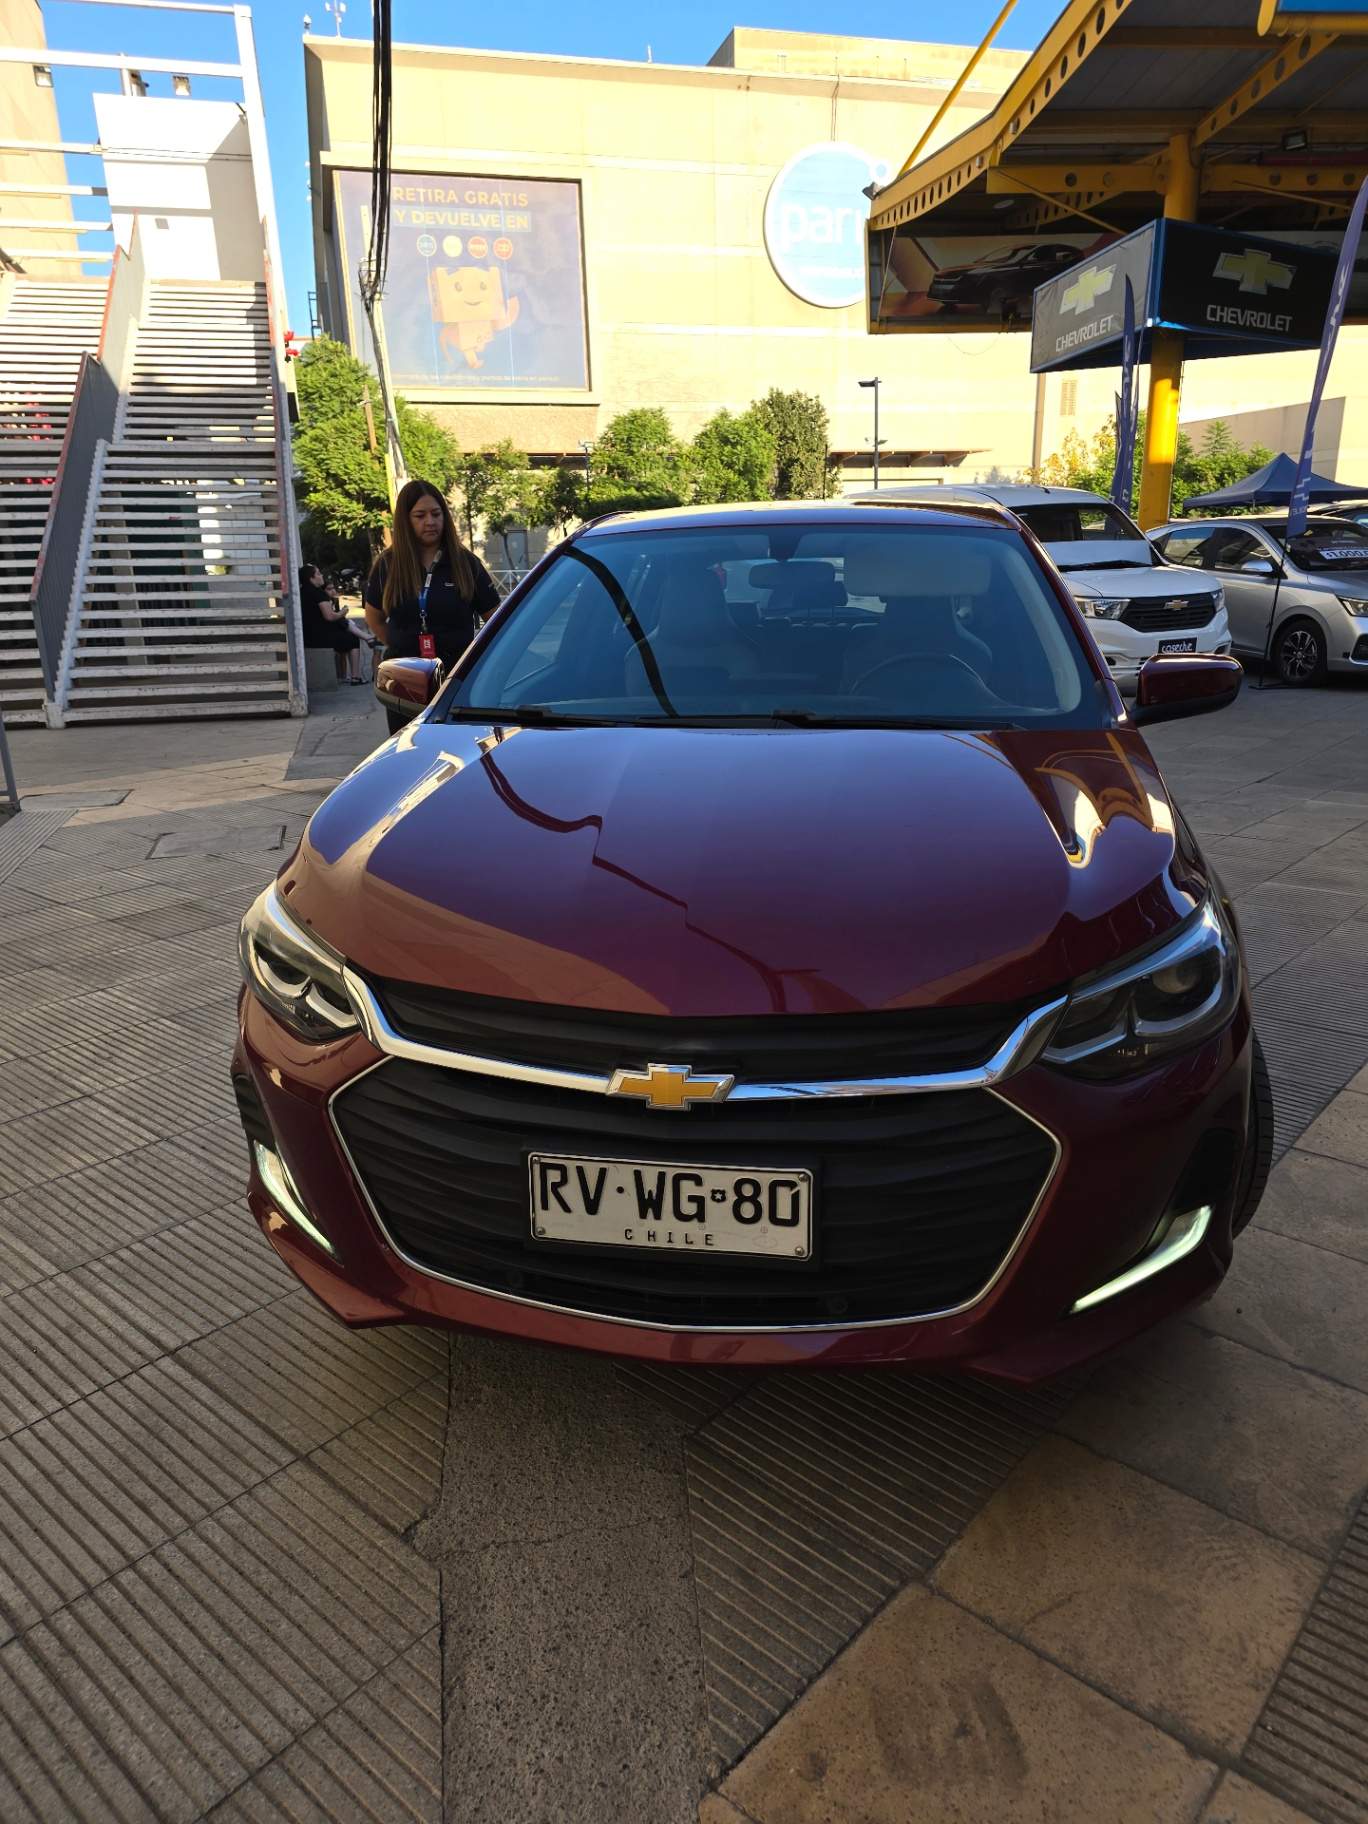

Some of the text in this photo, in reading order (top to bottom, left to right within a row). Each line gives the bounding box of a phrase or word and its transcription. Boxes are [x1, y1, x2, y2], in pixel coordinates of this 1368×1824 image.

[392, 186, 529, 207] RETIRA GRATIS
[395, 209, 529, 229] Y DEVUELVE EN
[780, 203, 865, 249] pari
[1206, 304, 1293, 332] CHEVROLET
[1055, 314, 1114, 352] CHEVROLET
[624, 1228, 714, 1246] CHILE
